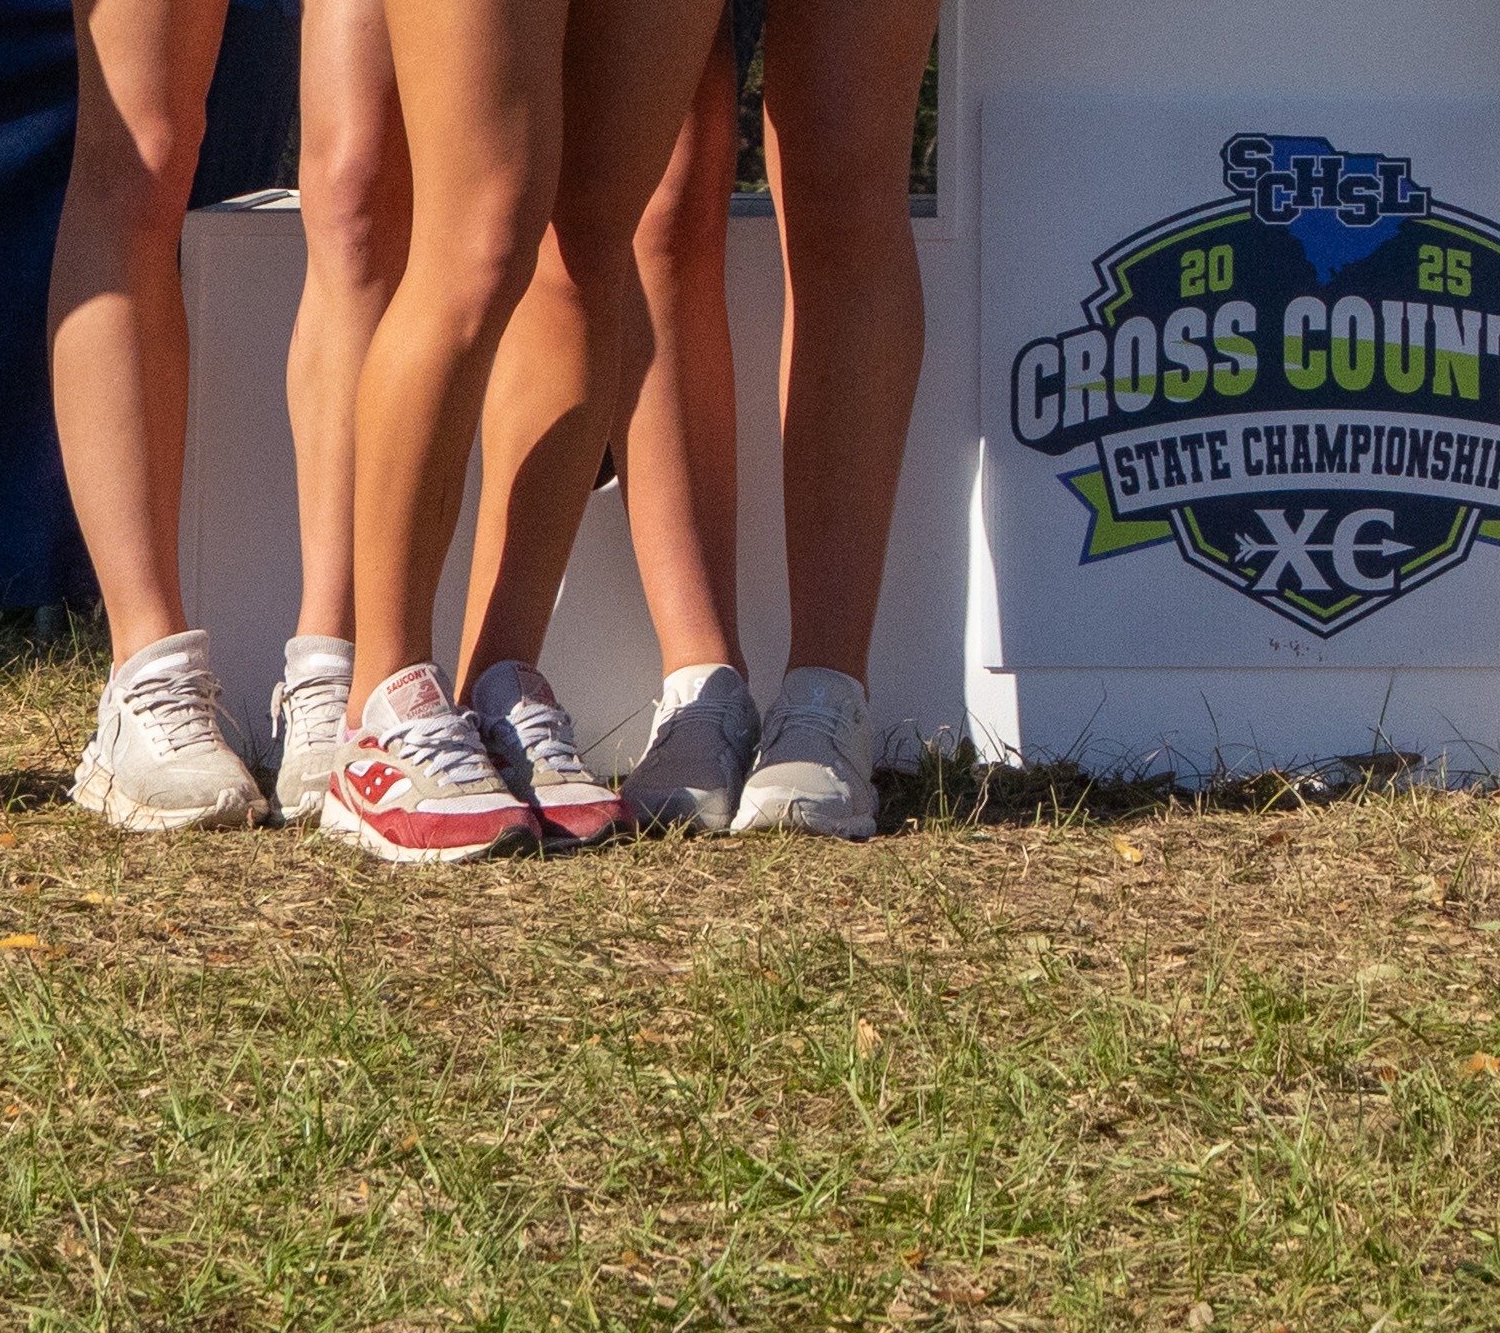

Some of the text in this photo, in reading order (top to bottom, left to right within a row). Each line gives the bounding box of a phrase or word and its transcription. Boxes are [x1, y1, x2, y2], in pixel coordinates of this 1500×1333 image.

[1227, 136, 1427, 228] SCHSL
[1181, 244, 1472, 297] 20 25
[1017, 301, 1258, 440] CROSS
[1116, 428, 1231, 496] STATE
[1252, 508, 1399, 591] XC
[386, 668, 427, 695] SAUCONY
